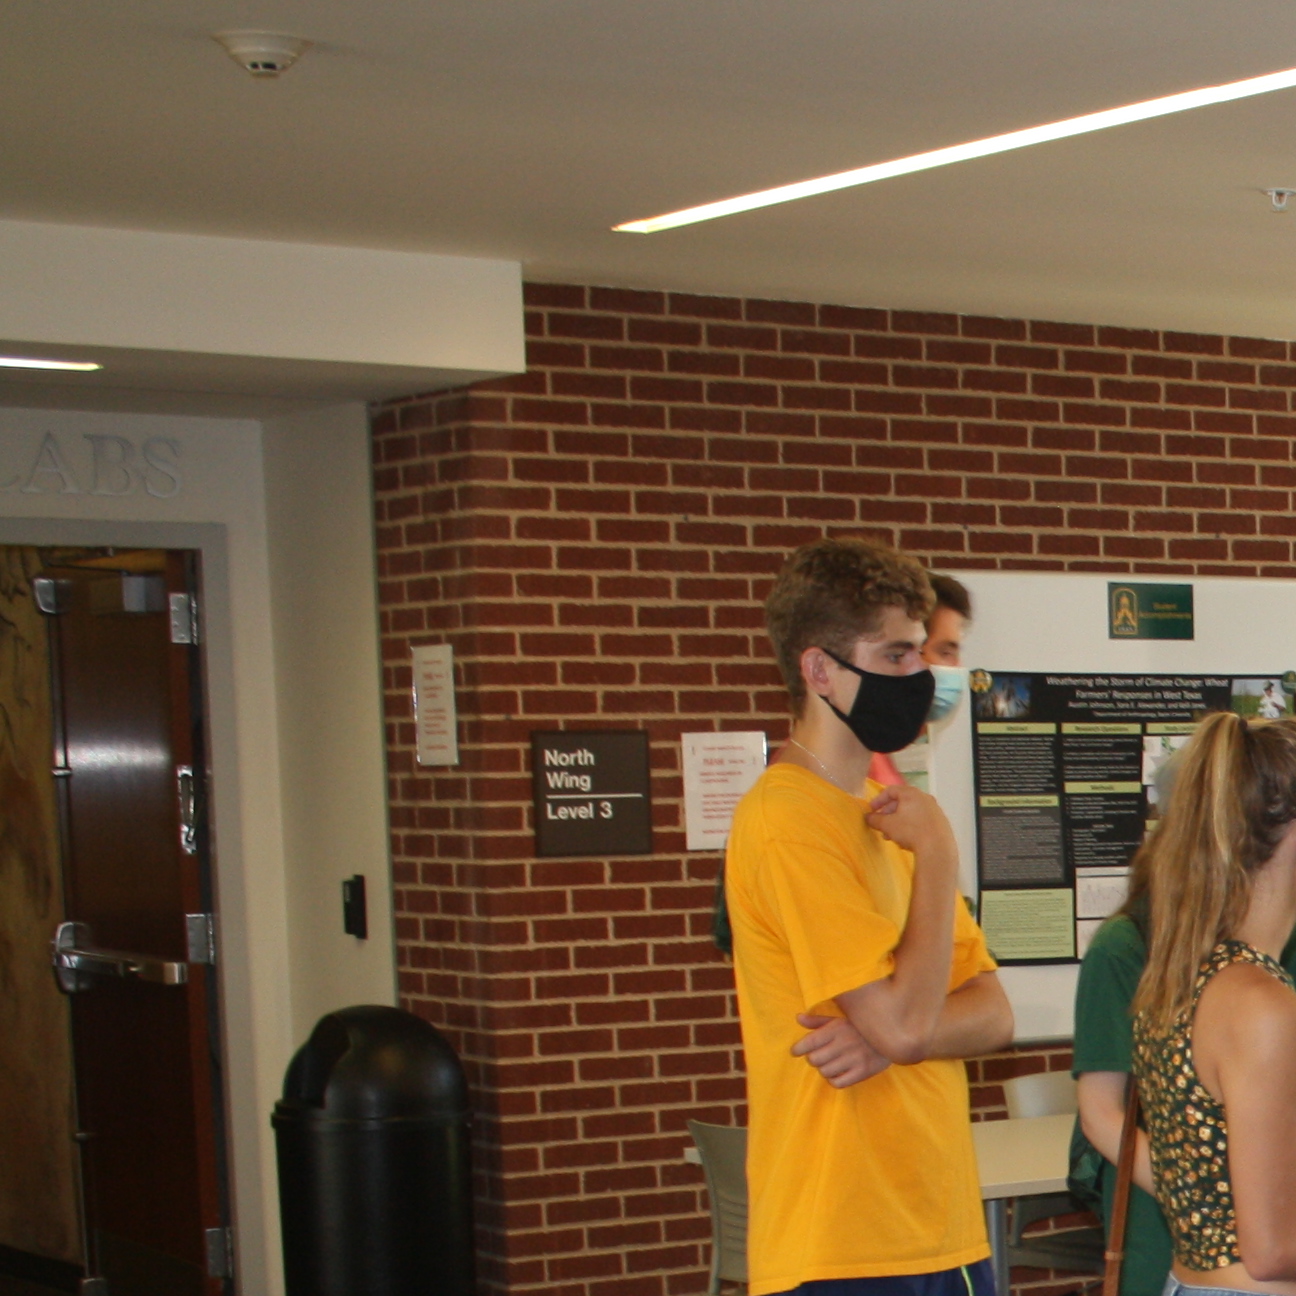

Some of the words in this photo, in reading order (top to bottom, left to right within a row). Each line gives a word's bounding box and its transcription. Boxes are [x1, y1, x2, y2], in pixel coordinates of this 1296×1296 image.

[544, 749, 595, 767] North
[546, 772, 592, 792] Wing
[546, 802, 595, 819] Level
[600, 801, 613, 819] 3
